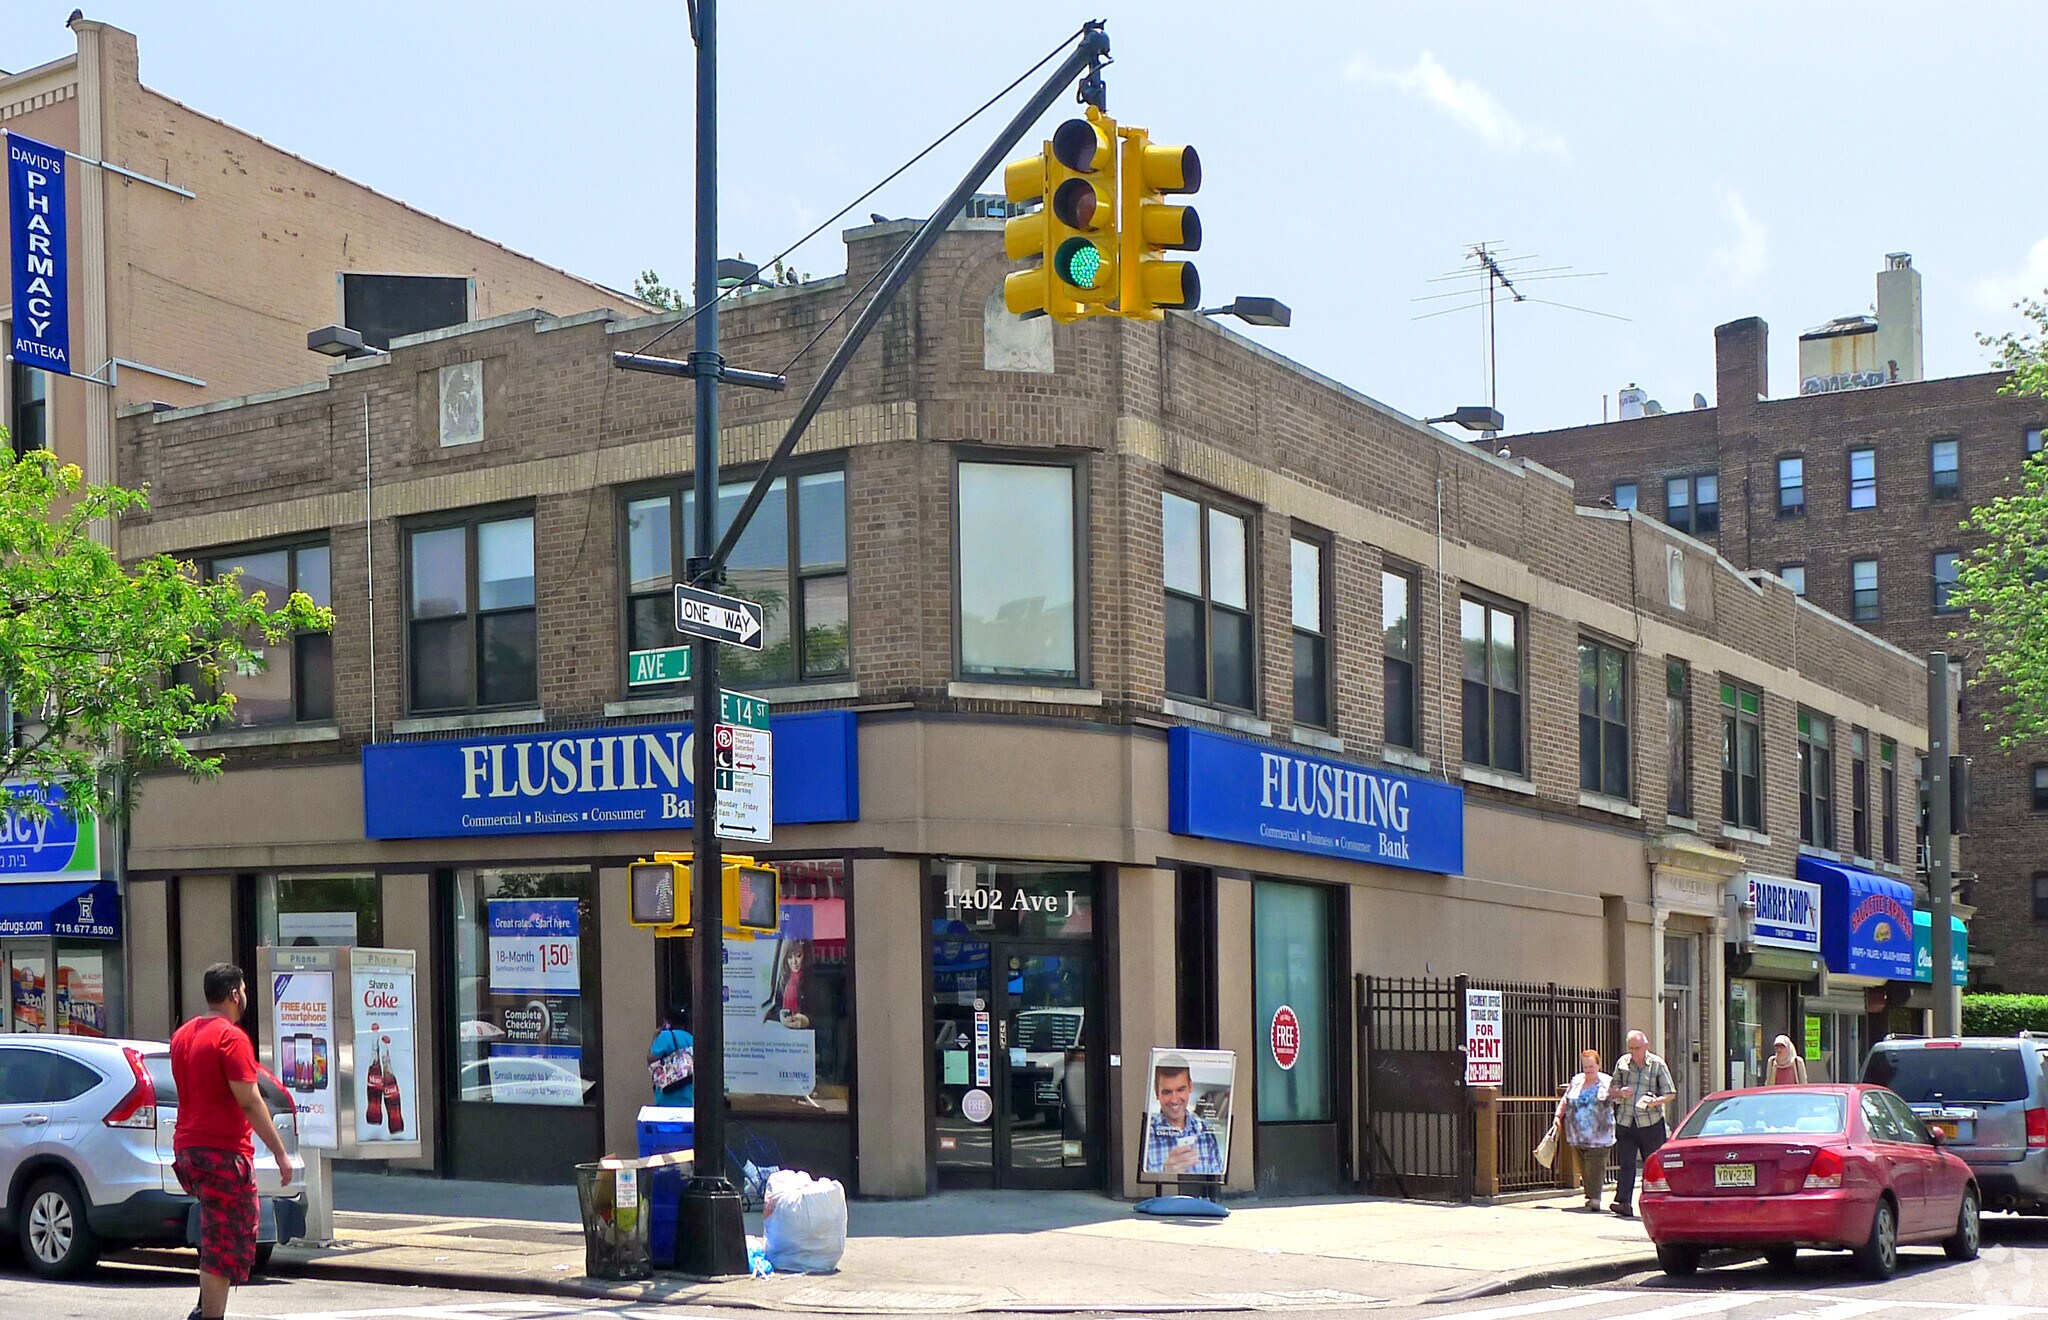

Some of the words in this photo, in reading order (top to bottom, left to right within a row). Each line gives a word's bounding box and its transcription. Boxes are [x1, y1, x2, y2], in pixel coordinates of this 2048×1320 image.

[11, 146, 61, 175] DAVID'S
[27, 170, 53, 338] PHARMACY
[16, 337, 66, 362] АПТЕКА
[684, 601, 710, 624] ONE
[724, 610, 751, 633] WAY
[636, 653, 666, 681] AVE
[678, 651, 688, 676] J
[720, 694, 730, 720] E
[736, 698, 752, 725] 14
[756, 703, 766, 717] ST
[735, 737, 754, 746] Thursday
[735, 744, 754, 752] Saturday
[721, 771, 727, 789] 1
[1260, 752, 1410, 832] FLUSHING
[661, 792, 694, 820] Ba
[718, 799, 738, 809] Monday
[742, 802, 759, 812] Friday
[462, 814, 522, 828] Commercial
[534, 810, 579, 824] Business
[591, 807, 646, 821] Consumer
[1260, 823, 1300, 842] Commercial
[1306, 831, 1334, 847] Business
[1340, 837, 1371, 853] Consumer
[1378, 832, 1410, 860] Bank
[943, 888, 1003, 911] 1402
[1010, 888, 1058, 912] Ave
[1065, 890, 1076, 917] J
[1756, 882, 1787, 922] BARBER
[1788, 888, 1809, 925] SHOP
[495, 918, 514, 928] Great
[535, 918, 553, 928] Start
[1851, 893, 1884, 934] BAGUETTE
[1884, 894, 1913, 941] EXPRESS
[55, 924, 114, 934] 718.677.8500
[290, 954, 317, 963] Phone
[368, 955, 398, 965] Phone
[496, 951, 535, 963] 18-Month
[540, 944, 569, 973] 1.50
[369, 980, 389, 989] Share
[280, 1002, 300, 1012] FREE
[301, 1002, 312, 1012] 4G
[313, 1003, 327, 1012] LTE
[364, 990, 398, 1008] Coke
[281, 1013, 327, 1022] smartphone
[505, 1010, 542, 1020] Complete
[505, 1020, 542, 1031] Checking
[1475, 1024, 1493, 1036] FOR
[507, 1030, 539, 1040] Premier.
[1276, 1025, 1295, 1047] FREE
[1469, 1038, 1500, 1058] RENT
[494, 1071, 513, 1080] Small
[513, 1072, 536, 1082] enough
[295, 1104, 324, 1114] etroPCS
[968, 1100, 986, 1110] FREE
